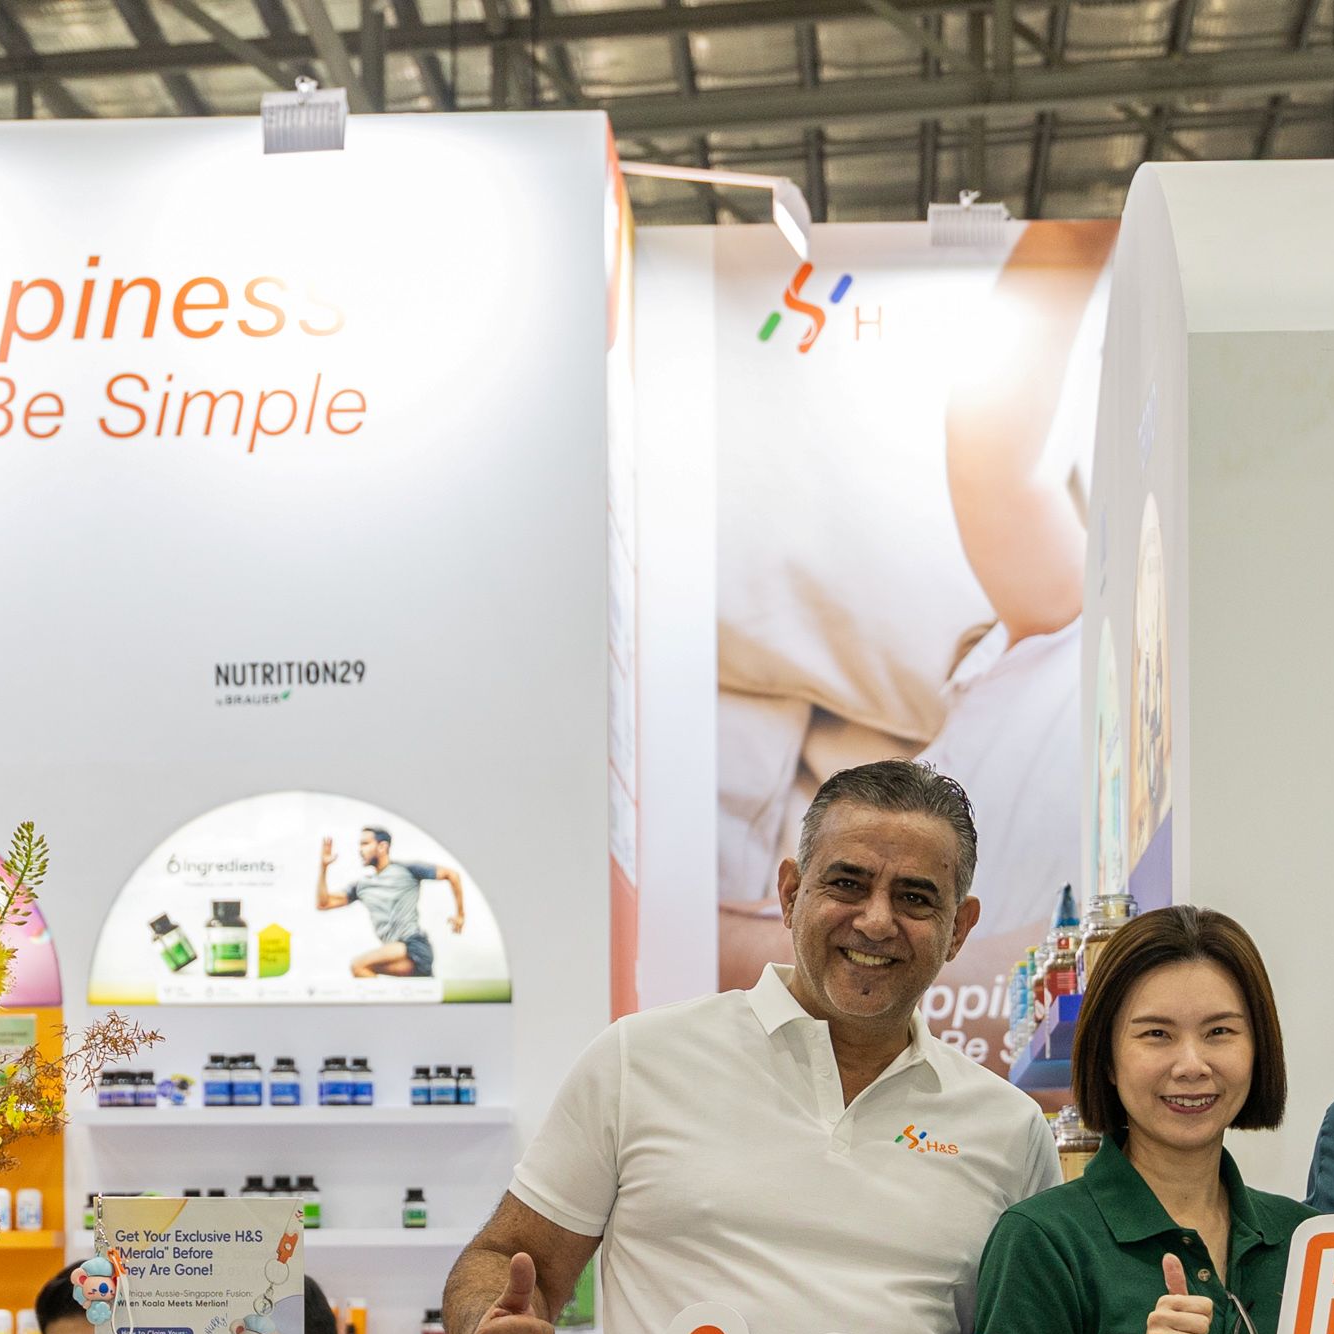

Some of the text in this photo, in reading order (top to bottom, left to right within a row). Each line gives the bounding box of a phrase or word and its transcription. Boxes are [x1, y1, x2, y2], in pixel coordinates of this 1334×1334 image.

[98, 372, 367, 453] Simple
[215, 660, 365, 687] NUTRITION29
[225, 693, 280, 705] BRAUER
[183, 857, 275, 876] Ingredients
[926, 1140, 959, 1155] H&S
[115, 1229, 263, 1242] Get Your Exclusive H&S
[116, 1247, 213, 1259] "Merala" Before
[122, 1264, 213, 1278] hey Are Gone!
[155, 1289, 224, 1298] Aussie-Singapore
[195, 1299, 229, 1307] Merlion!
